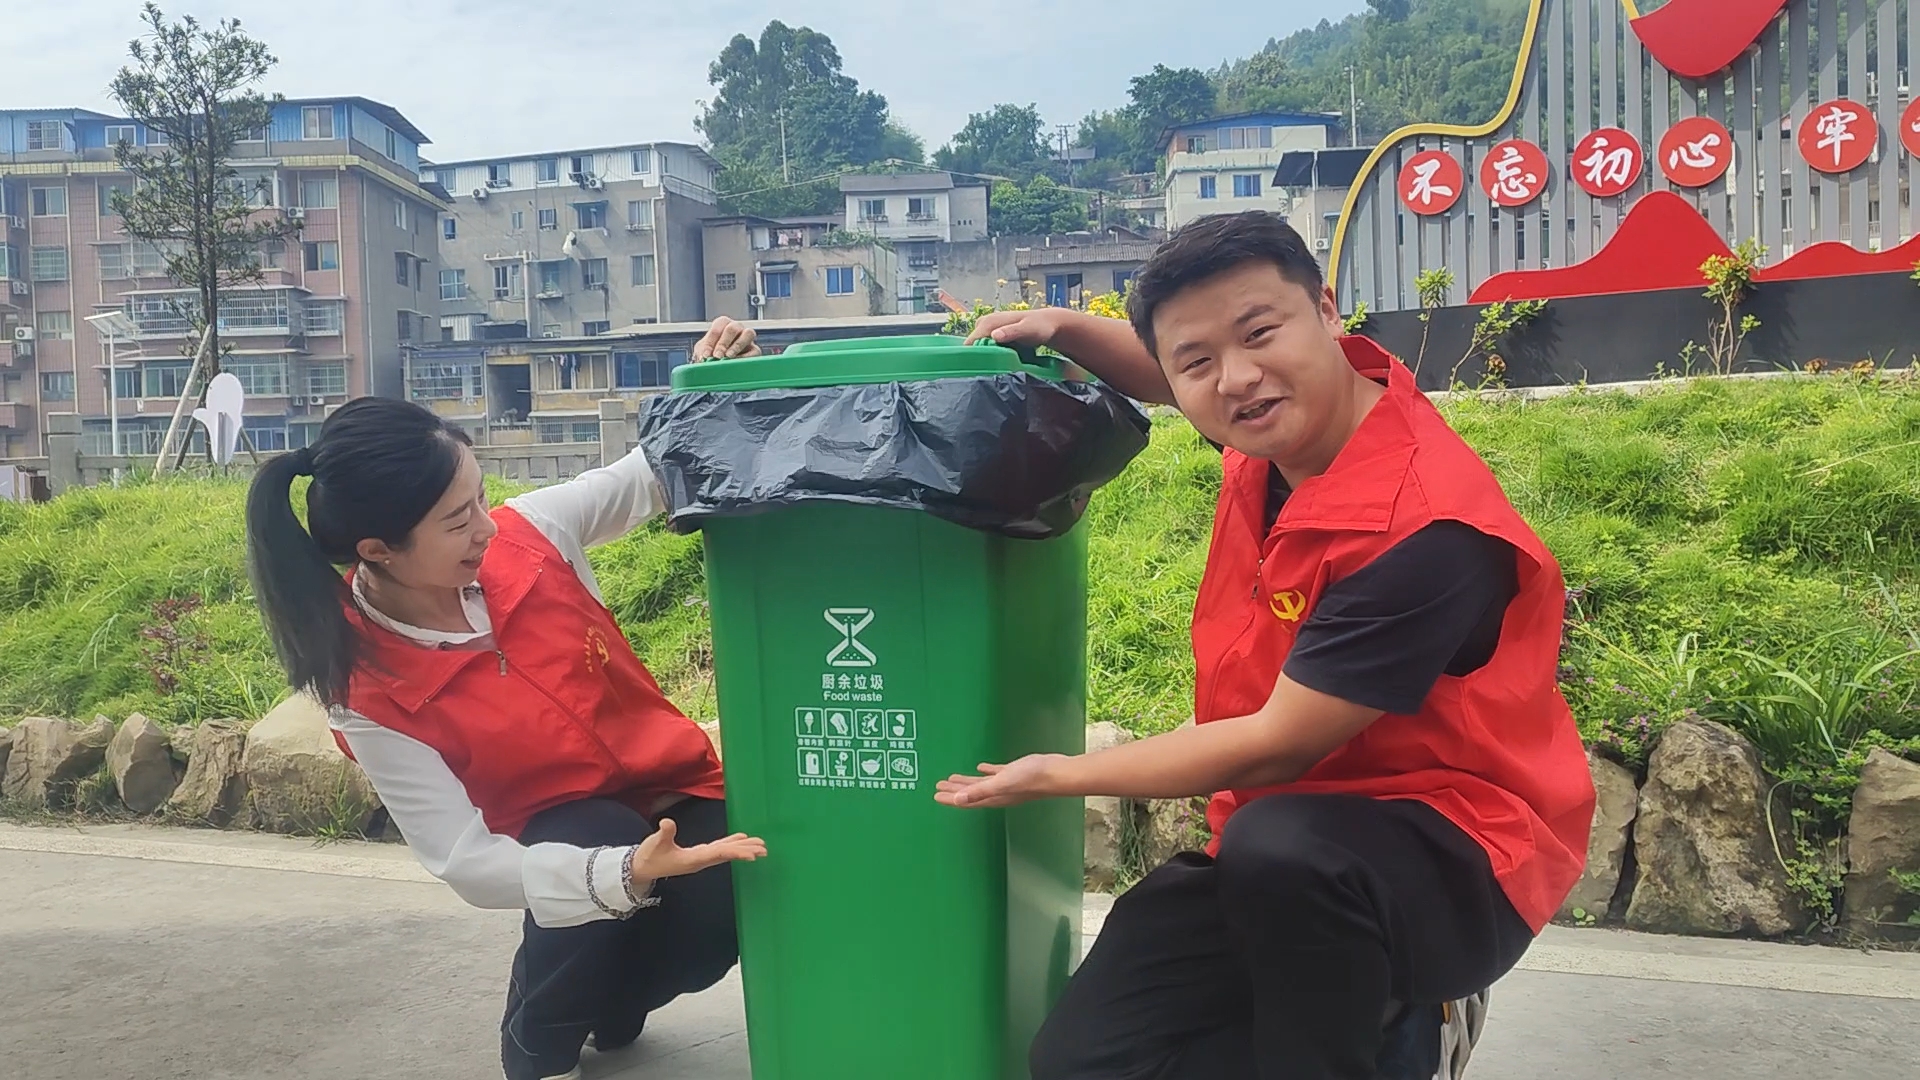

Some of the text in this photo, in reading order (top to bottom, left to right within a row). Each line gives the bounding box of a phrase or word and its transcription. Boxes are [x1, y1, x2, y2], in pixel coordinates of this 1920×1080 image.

[1407, 133, 1721, 205] 不忘初心
[822, 673, 884, 690] 厨余垃圾
[823, 691, 883, 702] Food waste
